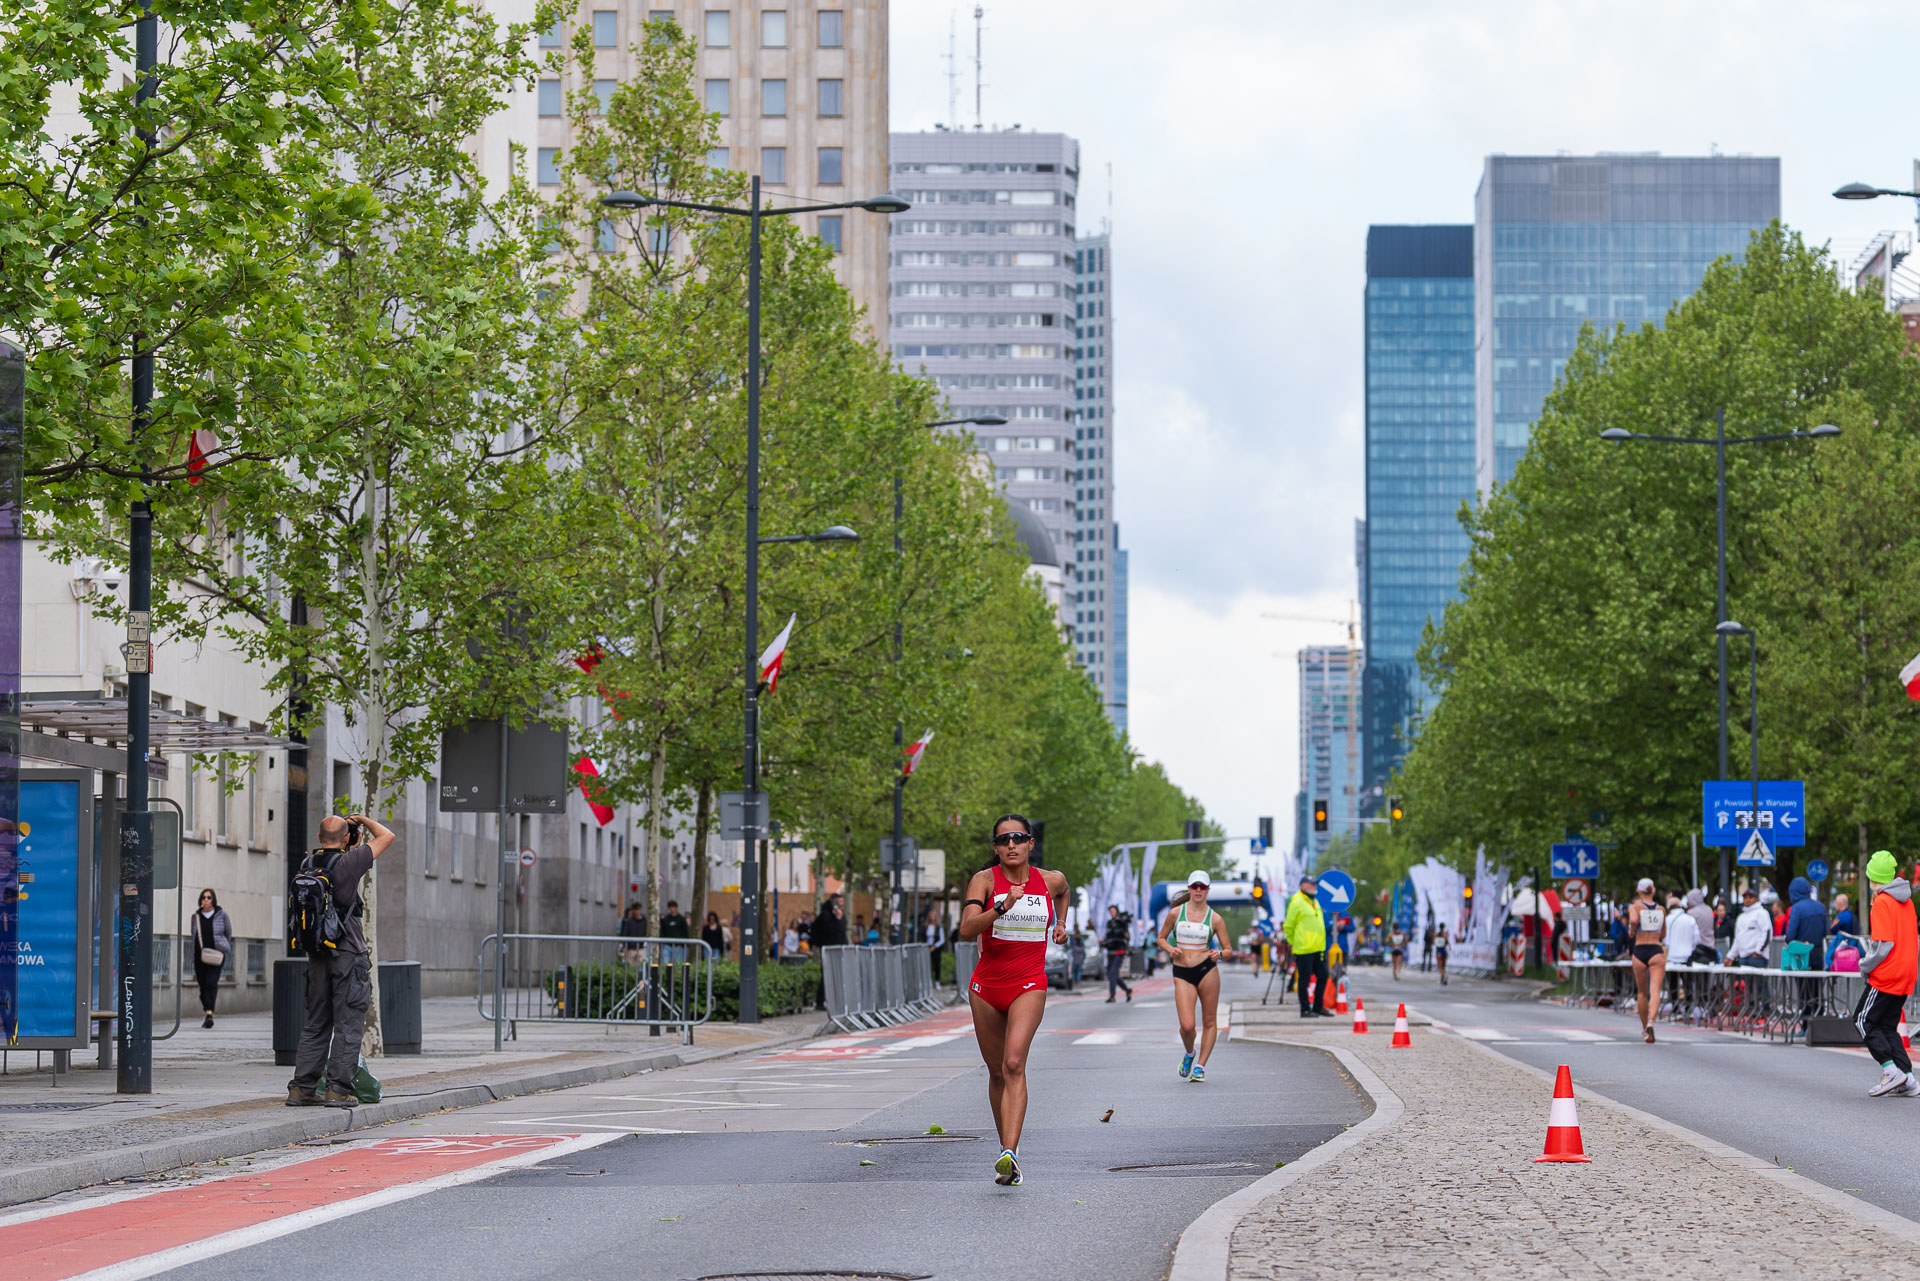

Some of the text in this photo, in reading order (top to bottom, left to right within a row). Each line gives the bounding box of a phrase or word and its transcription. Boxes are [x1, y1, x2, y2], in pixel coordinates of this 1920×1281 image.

[1027, 896, 1041, 907] 54
[1000, 912, 1047, 923] RTUÑO MARTINEZ
